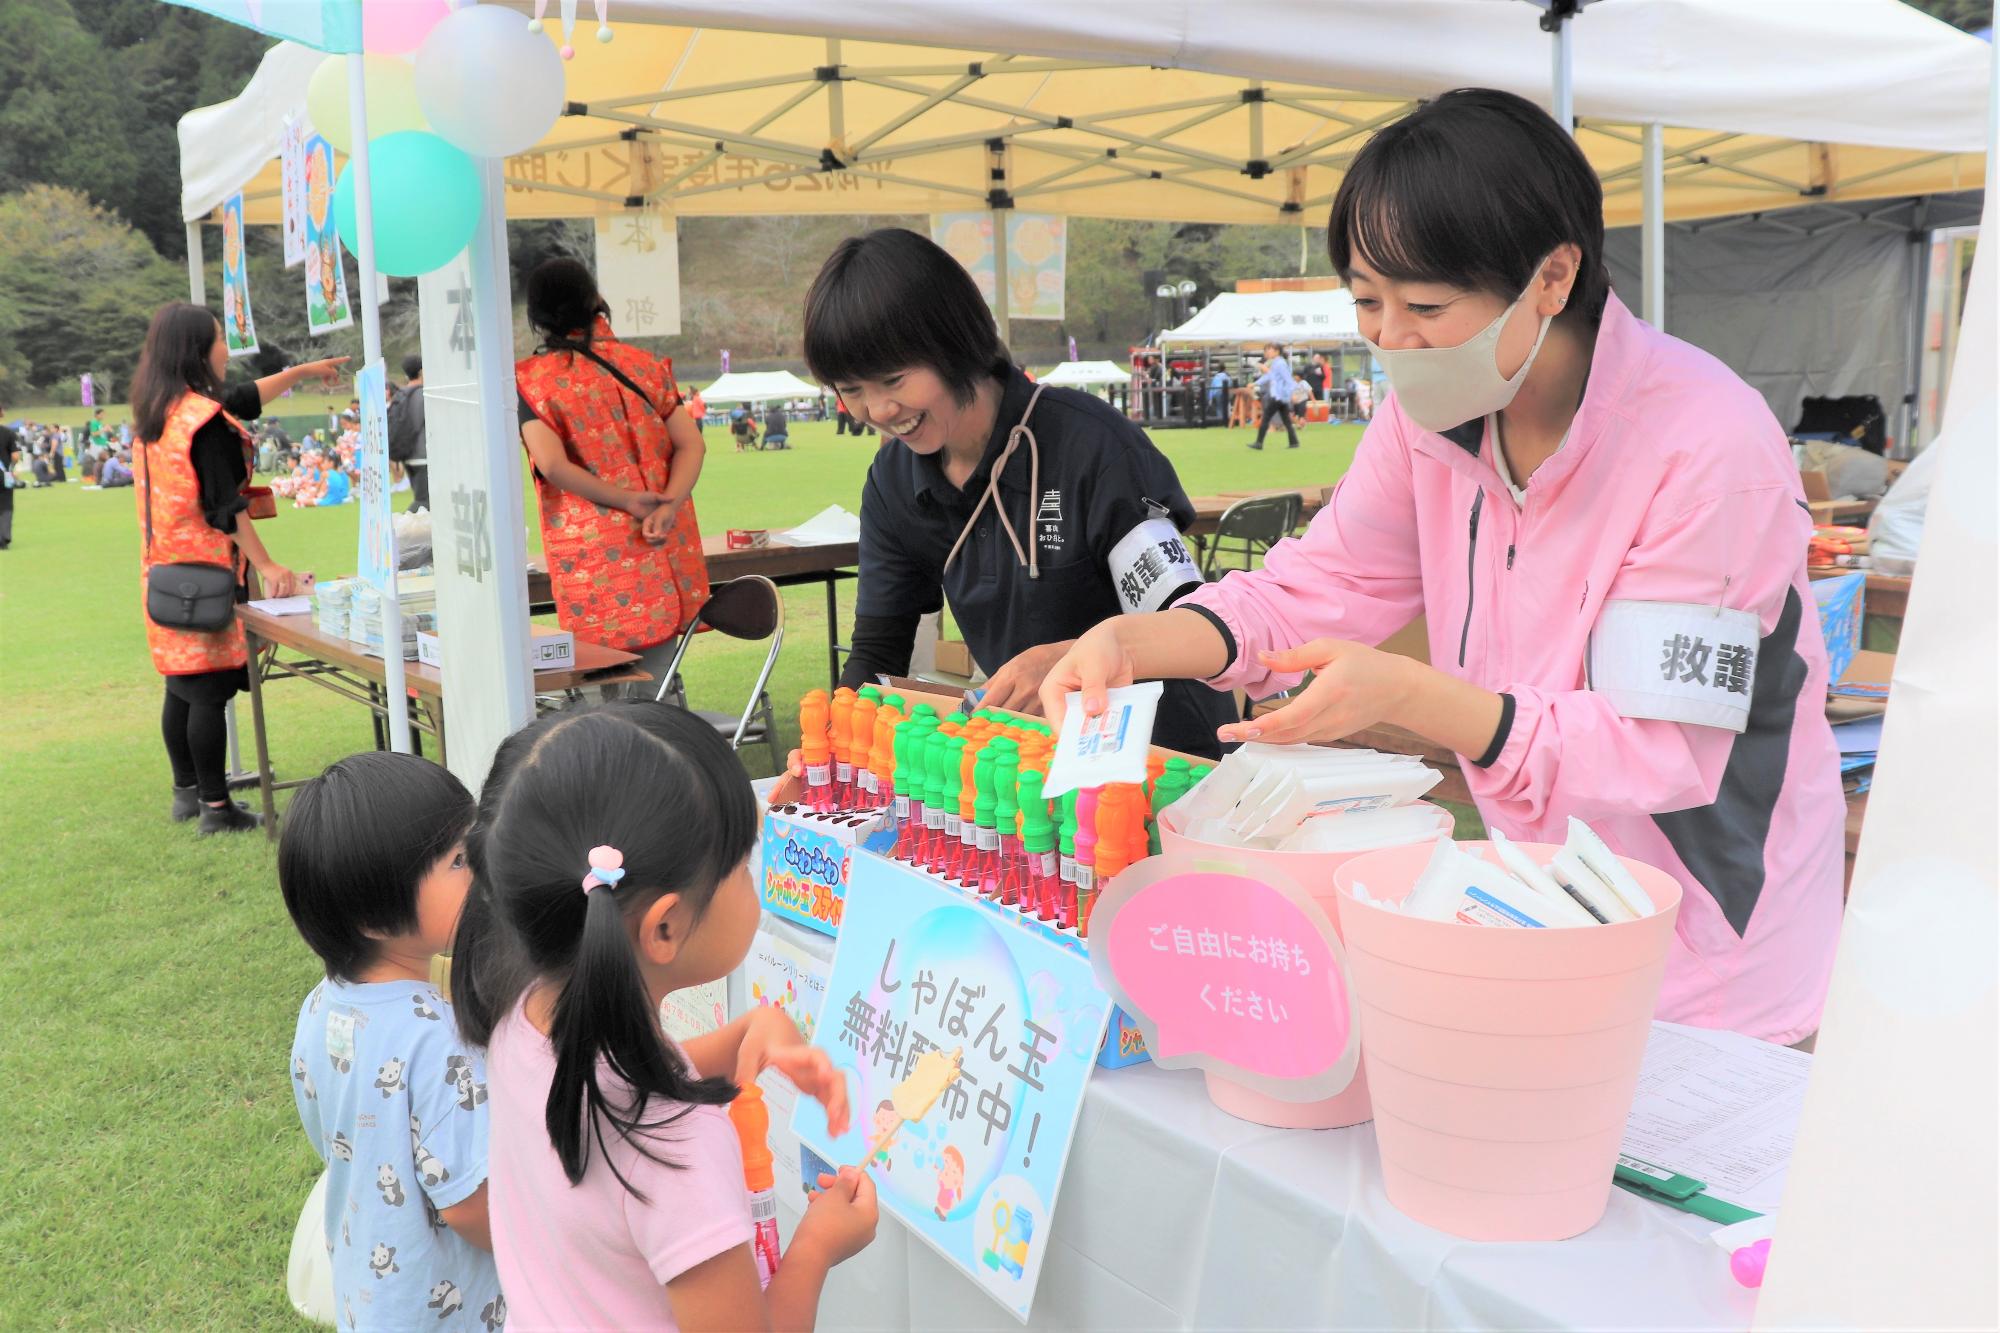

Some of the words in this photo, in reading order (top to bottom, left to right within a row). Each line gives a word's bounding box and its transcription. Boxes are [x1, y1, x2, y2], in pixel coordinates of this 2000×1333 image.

[1660, 633, 1754, 696] 救護
[784, 838, 840, 886] ふわふわ
[1148, 924, 1311, 977] ご自由にお持ち
[880, 938, 1057, 1092] しゃぼん玉
[1200, 983, 1289, 1024] ください
